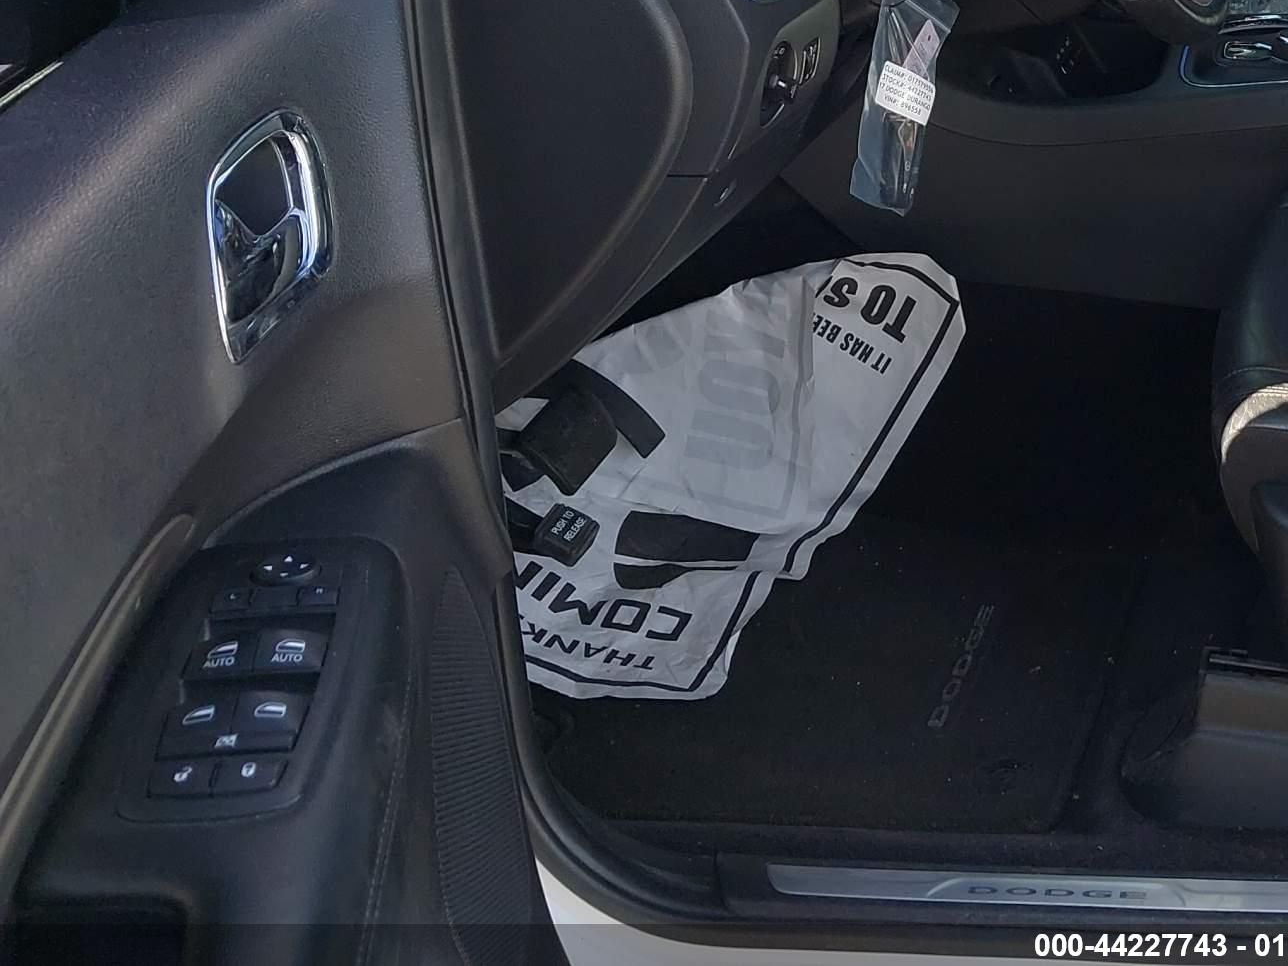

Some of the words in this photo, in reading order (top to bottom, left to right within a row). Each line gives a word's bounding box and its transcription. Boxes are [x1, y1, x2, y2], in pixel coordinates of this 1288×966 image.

[815, 275, 858, 308] S
[860, 284, 917, 344] TO
[839, 333, 875, 364] HAS
[871, 352, 892, 375] IT
[551, 518, 568, 535] PUSH
[563, 516, 587, 542] RELEASE
[202, 656, 236, 670] AUTO
[271, 653, 303, 663] AUTO
[967, 886, 1147, 900] DODGE
